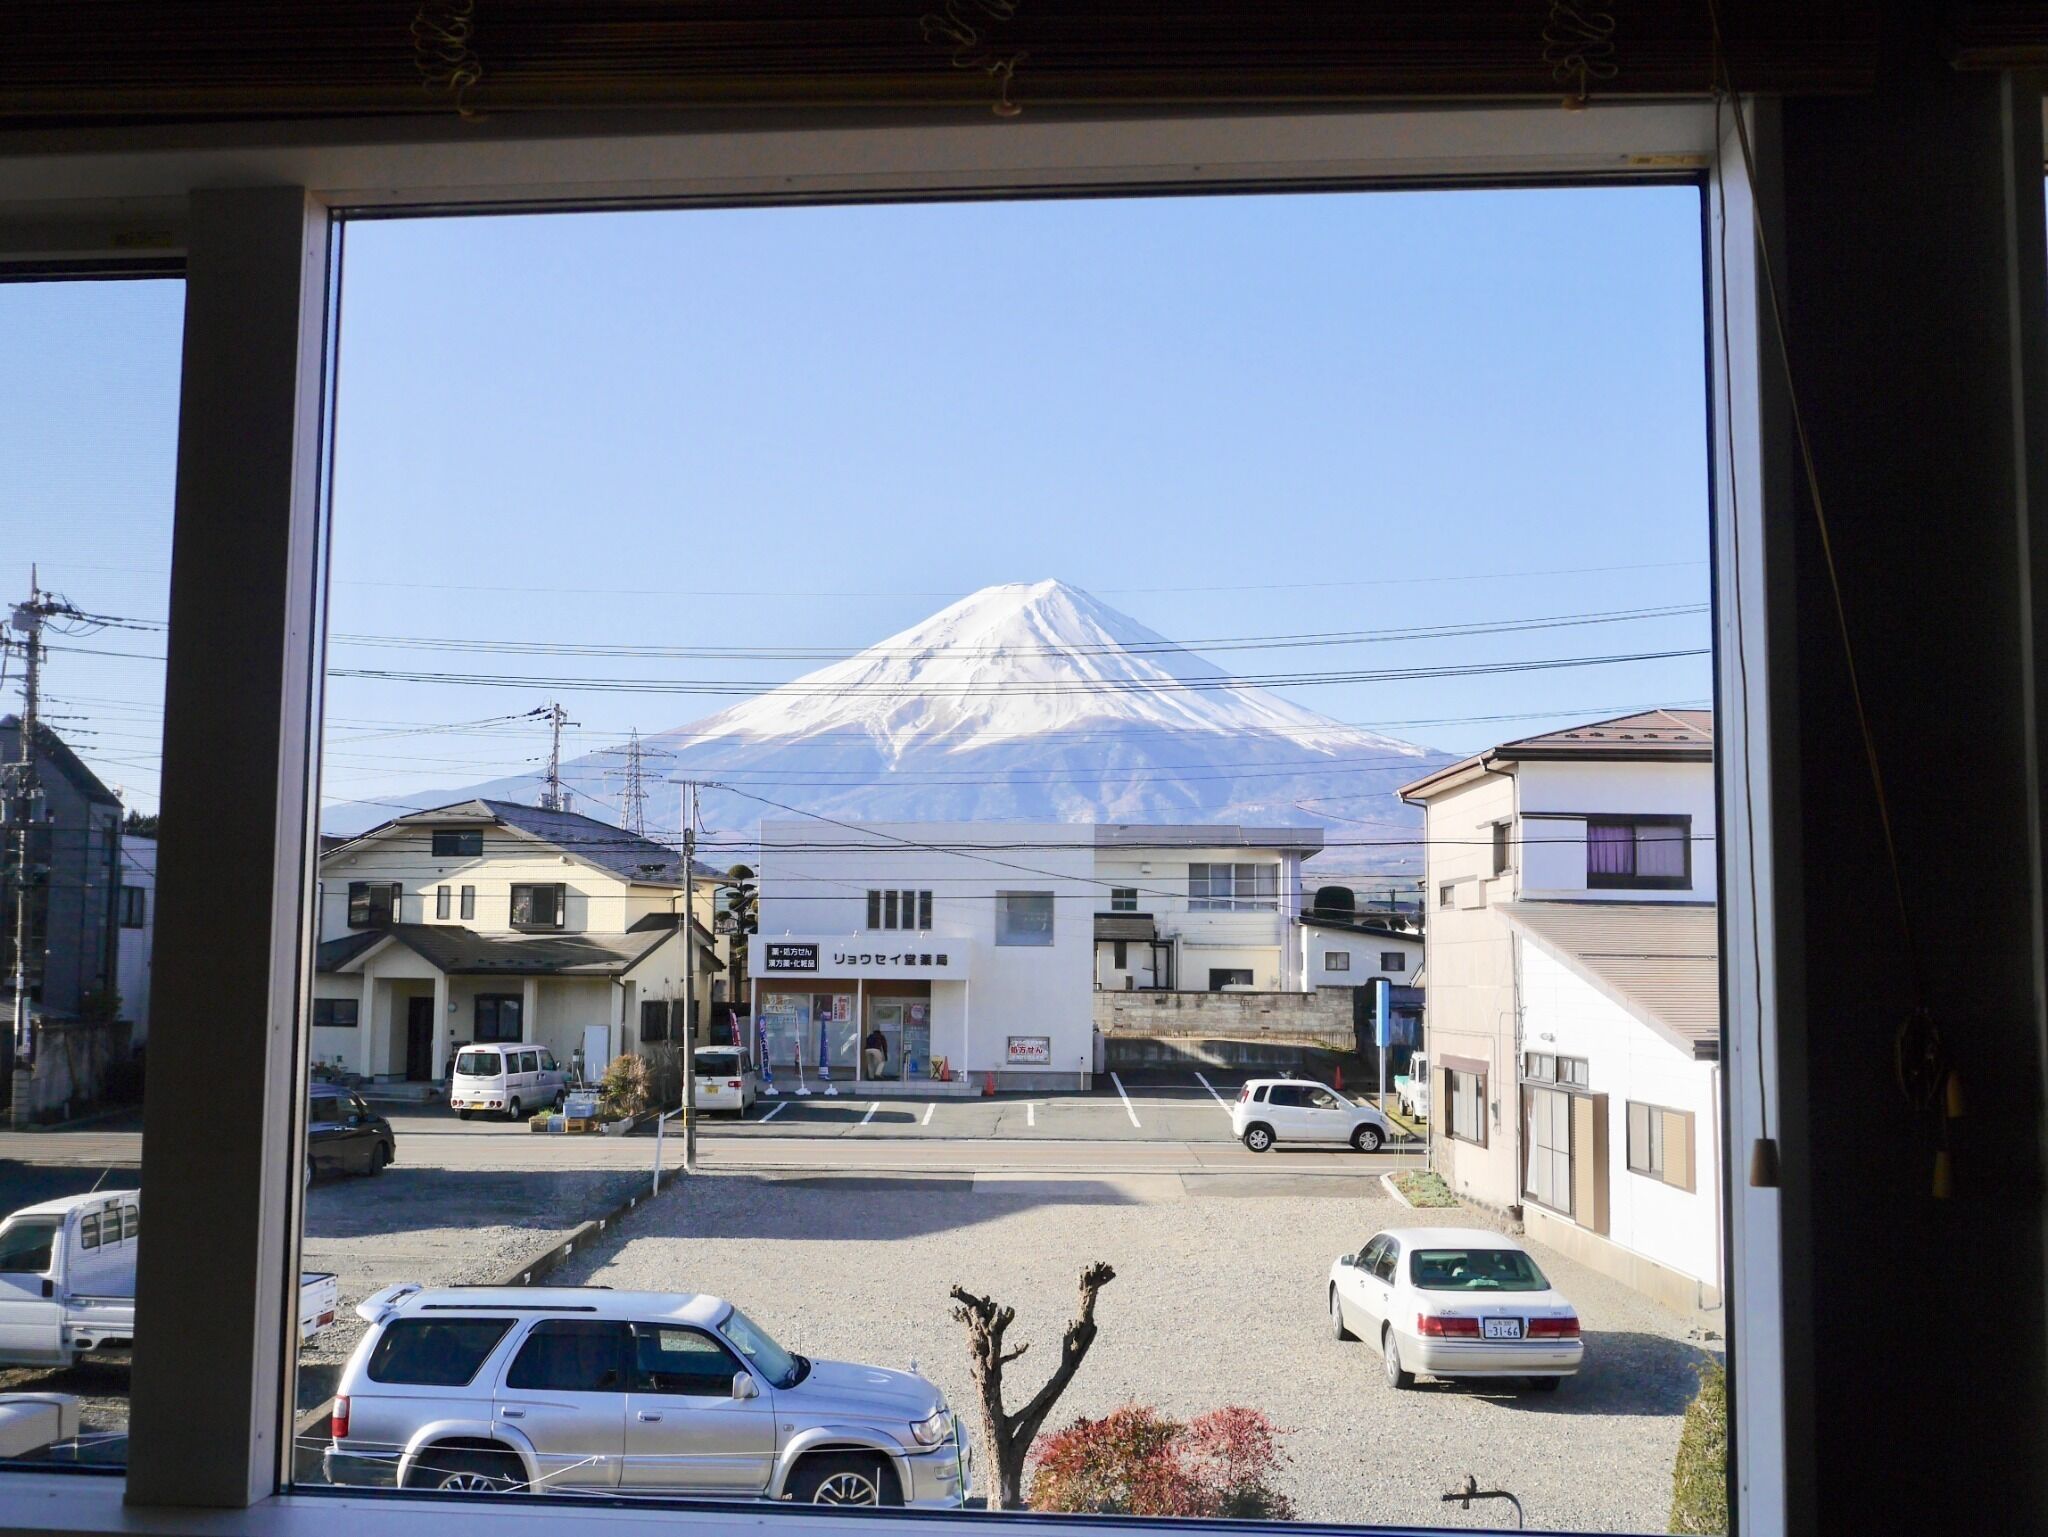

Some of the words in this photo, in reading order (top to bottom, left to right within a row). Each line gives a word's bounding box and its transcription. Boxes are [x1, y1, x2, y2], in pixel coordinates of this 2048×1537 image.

[771, 947, 813, 956] 薬・処方せん
[768, 959, 815, 968] 漢方薬・化粧品
[834, 953, 948, 966] リョウセイ堂薬局
